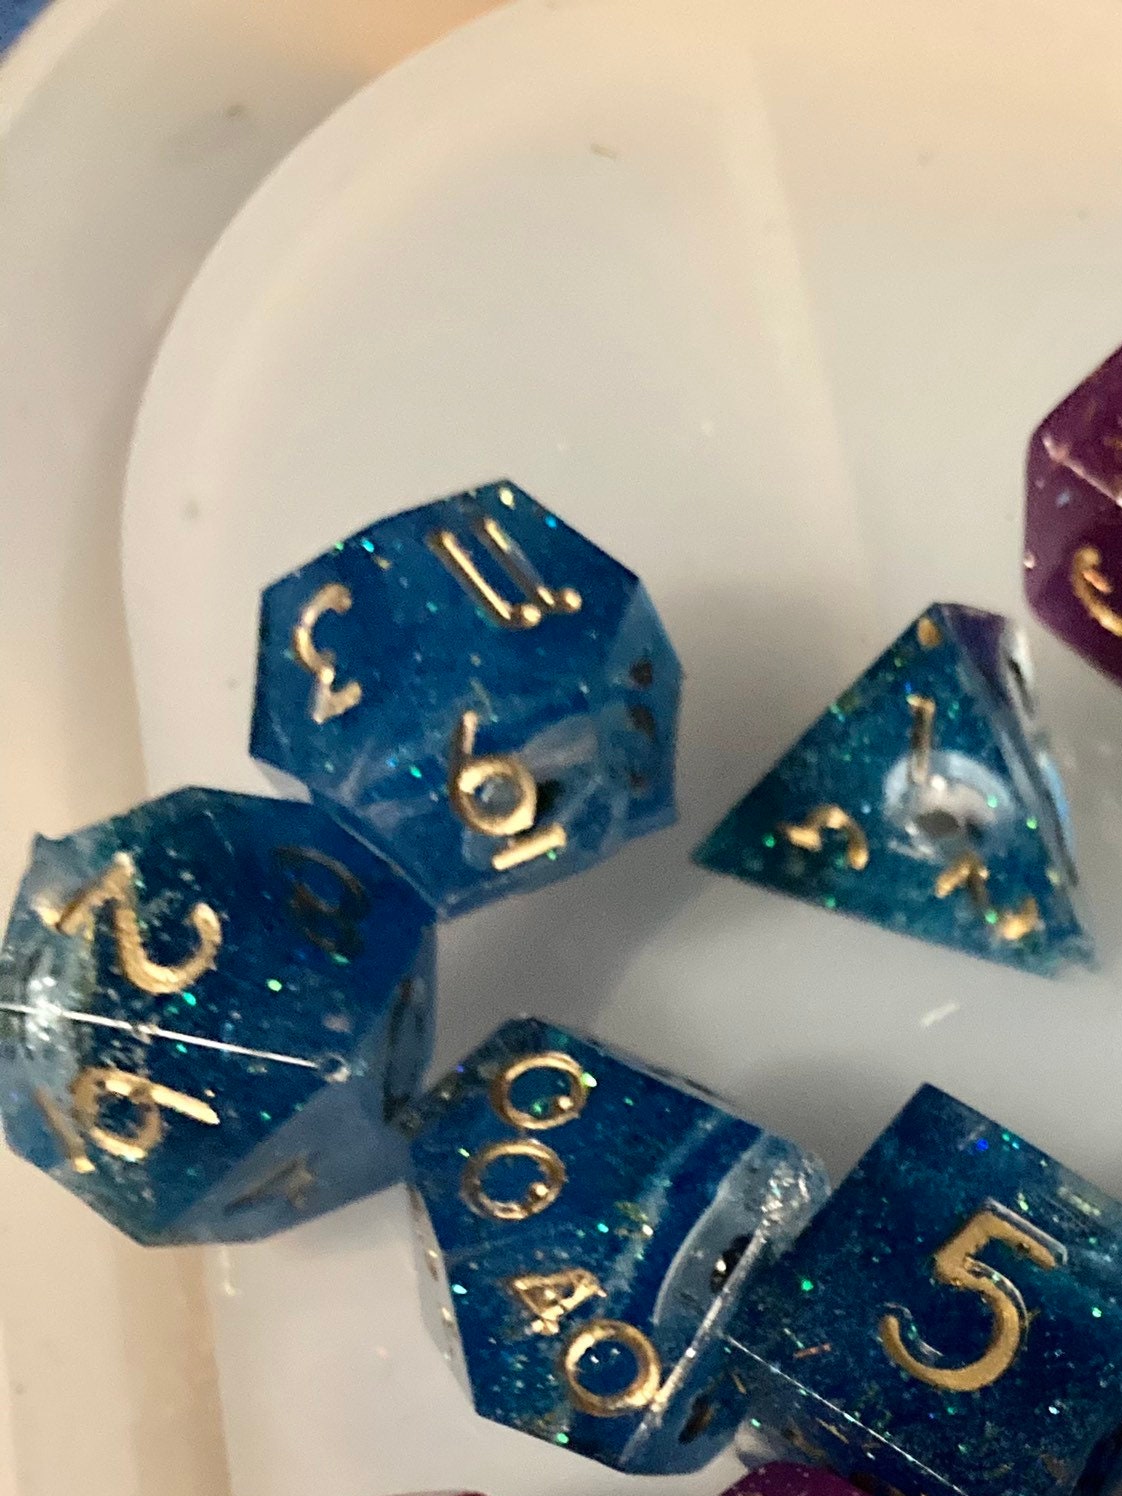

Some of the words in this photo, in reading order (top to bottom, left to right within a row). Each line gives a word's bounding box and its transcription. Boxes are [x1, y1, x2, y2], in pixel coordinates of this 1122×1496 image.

[460, 1050, 589, 1221] 00
[508, 1267, 661, 1418] 40
[879, 1198, 1068, 1392] 5
